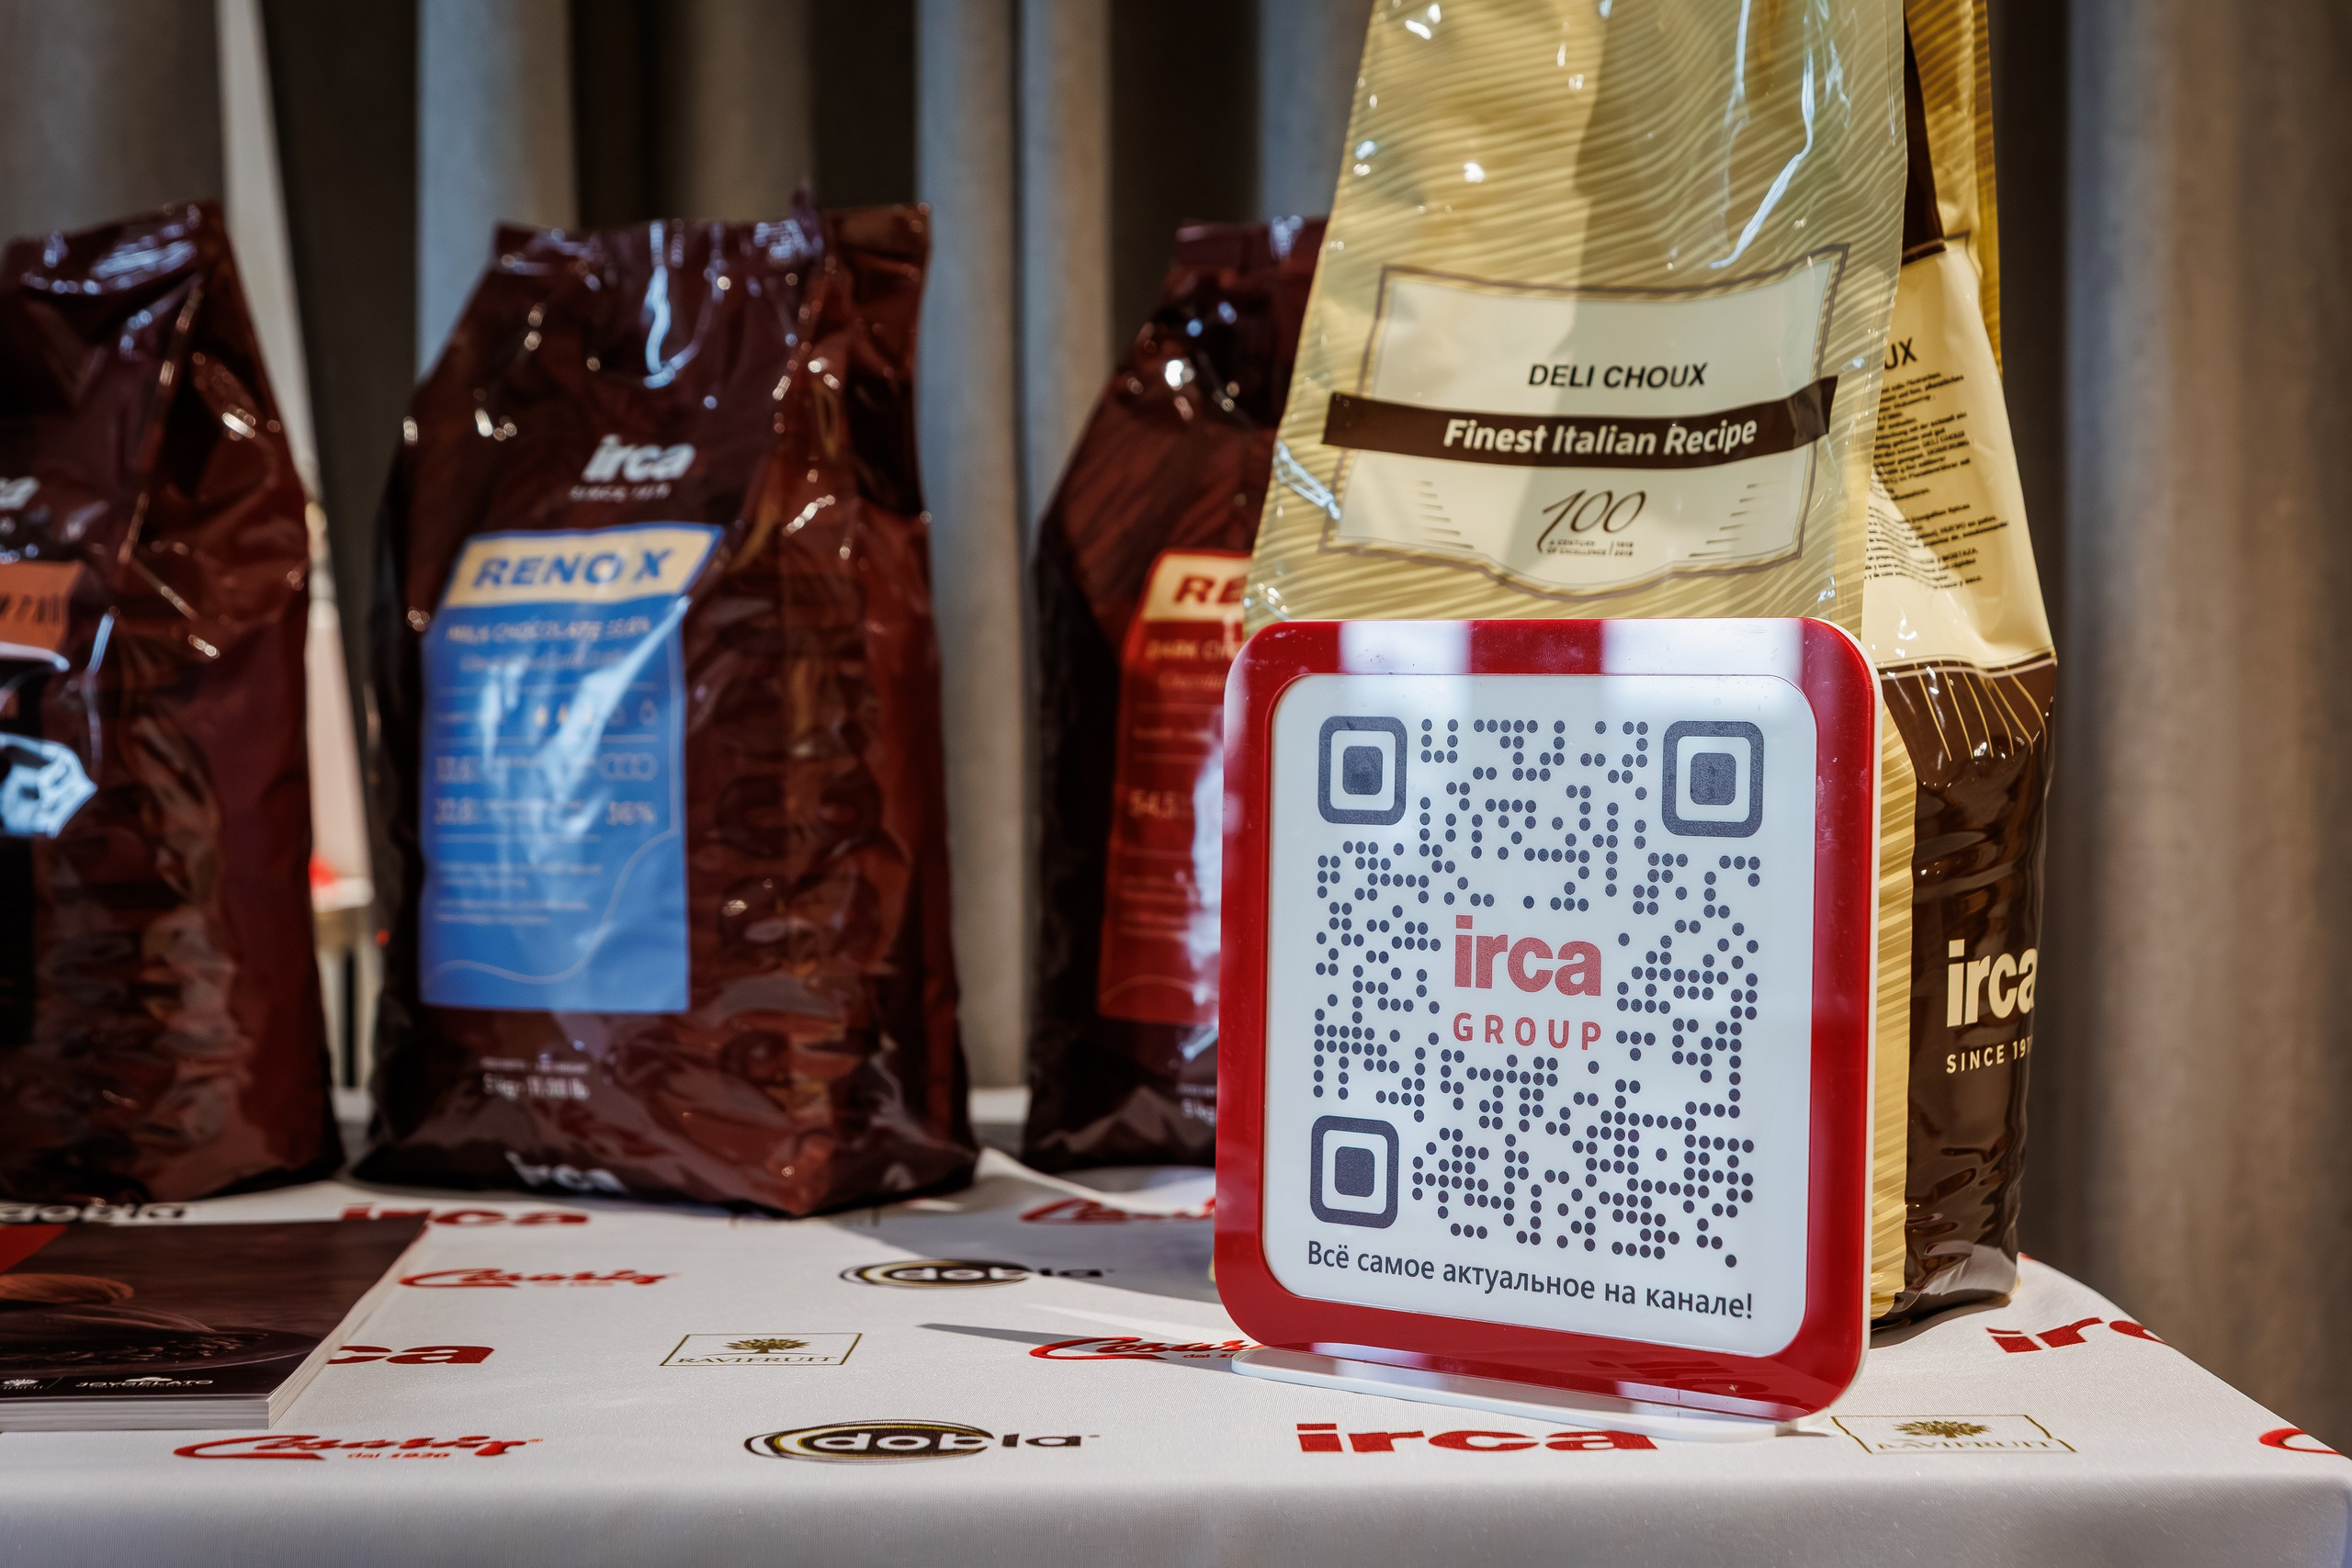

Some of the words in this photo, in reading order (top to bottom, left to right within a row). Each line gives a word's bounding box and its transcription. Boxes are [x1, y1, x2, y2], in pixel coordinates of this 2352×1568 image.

[1529, 364, 1595, 387] DELI
[1603, 363, 1709, 388] CHOUX
[1443, 418, 1547, 454] Finest
[1552, 424, 1657, 455] Italian
[1663, 419, 1758, 456] Recipe
[1536, 489, 1647, 554] 100
[1454, 915, 1602, 997] irca
[1947, 938, 2039, 1029] irca
[1453, 1012, 1602, 1051] GROUP
[1946, 1043, 2006, 1075] SINCE
[1307, 1240, 1350, 1269] Всё
[1357, 1250, 1435, 1280] самое
[1442, 1262, 1596, 1300] актуальное
[1605, 1282, 1636, 1304] на
[1646, 1285, 1753, 1319] канале!
[677, 1356, 838, 1364] RAVIFRUIT
[1029, 1337, 1265, 1360] Cesar
[1296, 1423, 1658, 1453] irca
